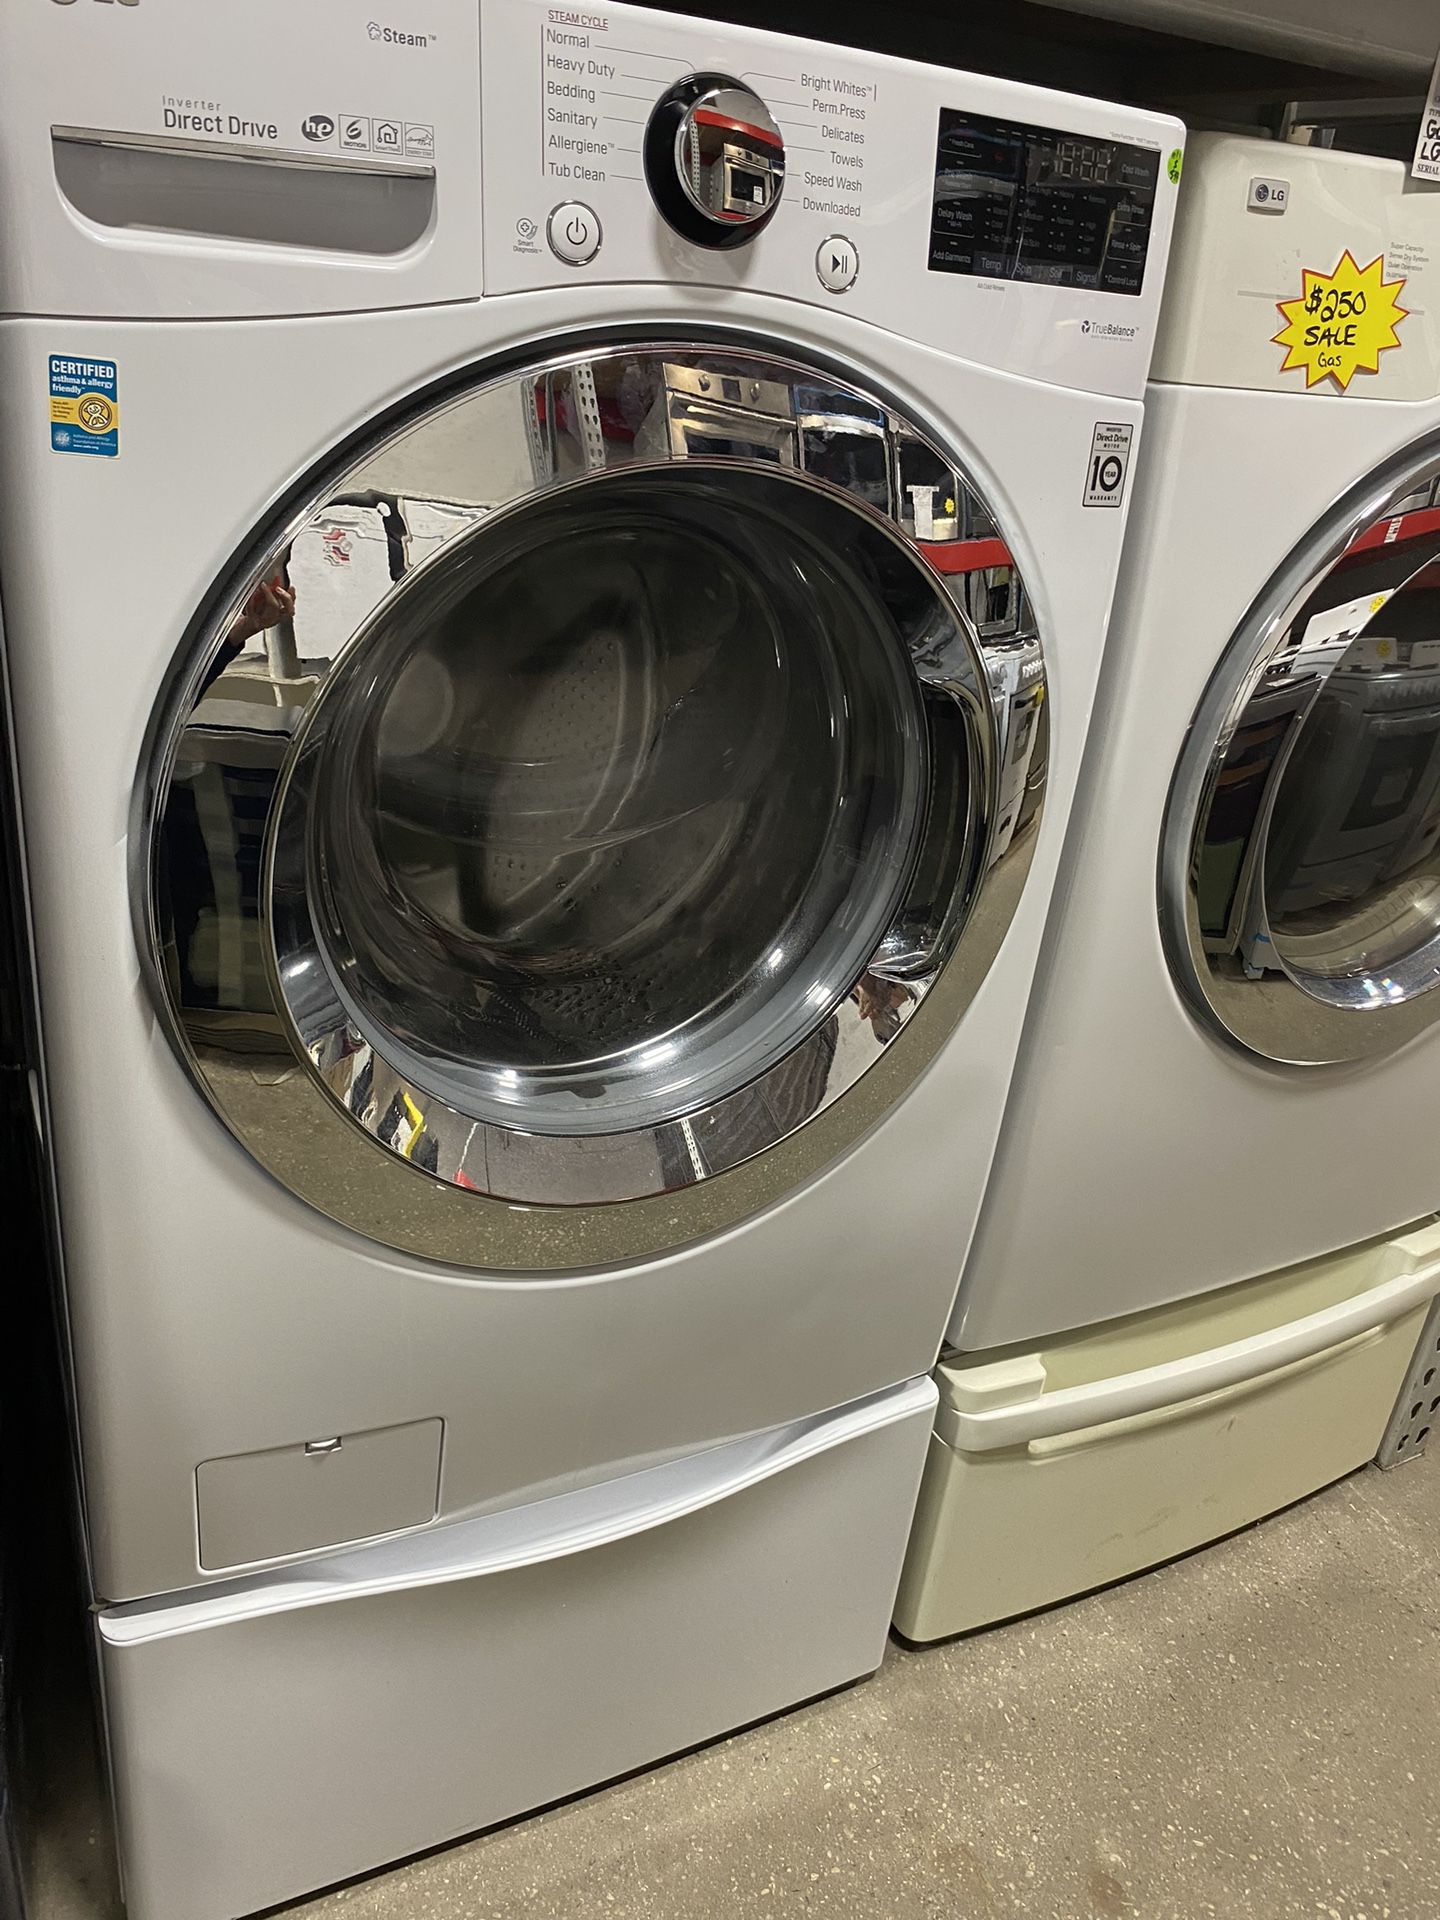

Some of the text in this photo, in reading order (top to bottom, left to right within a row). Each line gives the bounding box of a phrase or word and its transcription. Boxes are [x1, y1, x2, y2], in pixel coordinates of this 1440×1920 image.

[548, 10, 608, 28] STEAM CYCLE
[546, 28, 589, 48] Normal
[547, 54, 615, 80] Heavy Duty
[547, 80, 595, 104] Bedding
[801, 73, 831, 92] Bright
[162, 94, 221, 111] Inverter
[164, 108, 278, 139] Direct Drive
[548, 107, 597, 130] Sanitary
[822, 124, 865, 144] Delicates
[830, 150, 864, 168] Towels
[1417, 163, 1439, 175] SERIAL
[548, 162, 606, 182] Tub Clean
[804, 171, 862, 192] Speed Wash
[1271, 190, 1285, 201] LG
[802, 197, 861, 217] Downloaded
[1076, 271, 1097, 285] Signal
[1304, 283, 1366, 323] $250
[1304, 324, 1358, 348] SALE
[52, 360, 114, 379] CERTIFIED
[1318, 352, 1342, 368] Gas
[52, 375, 80, 385] asthma
[88, 379, 113, 390] allergy
[1096, 433, 1128, 443] Direct Drive
[1091, 456, 1122, 492] 10
